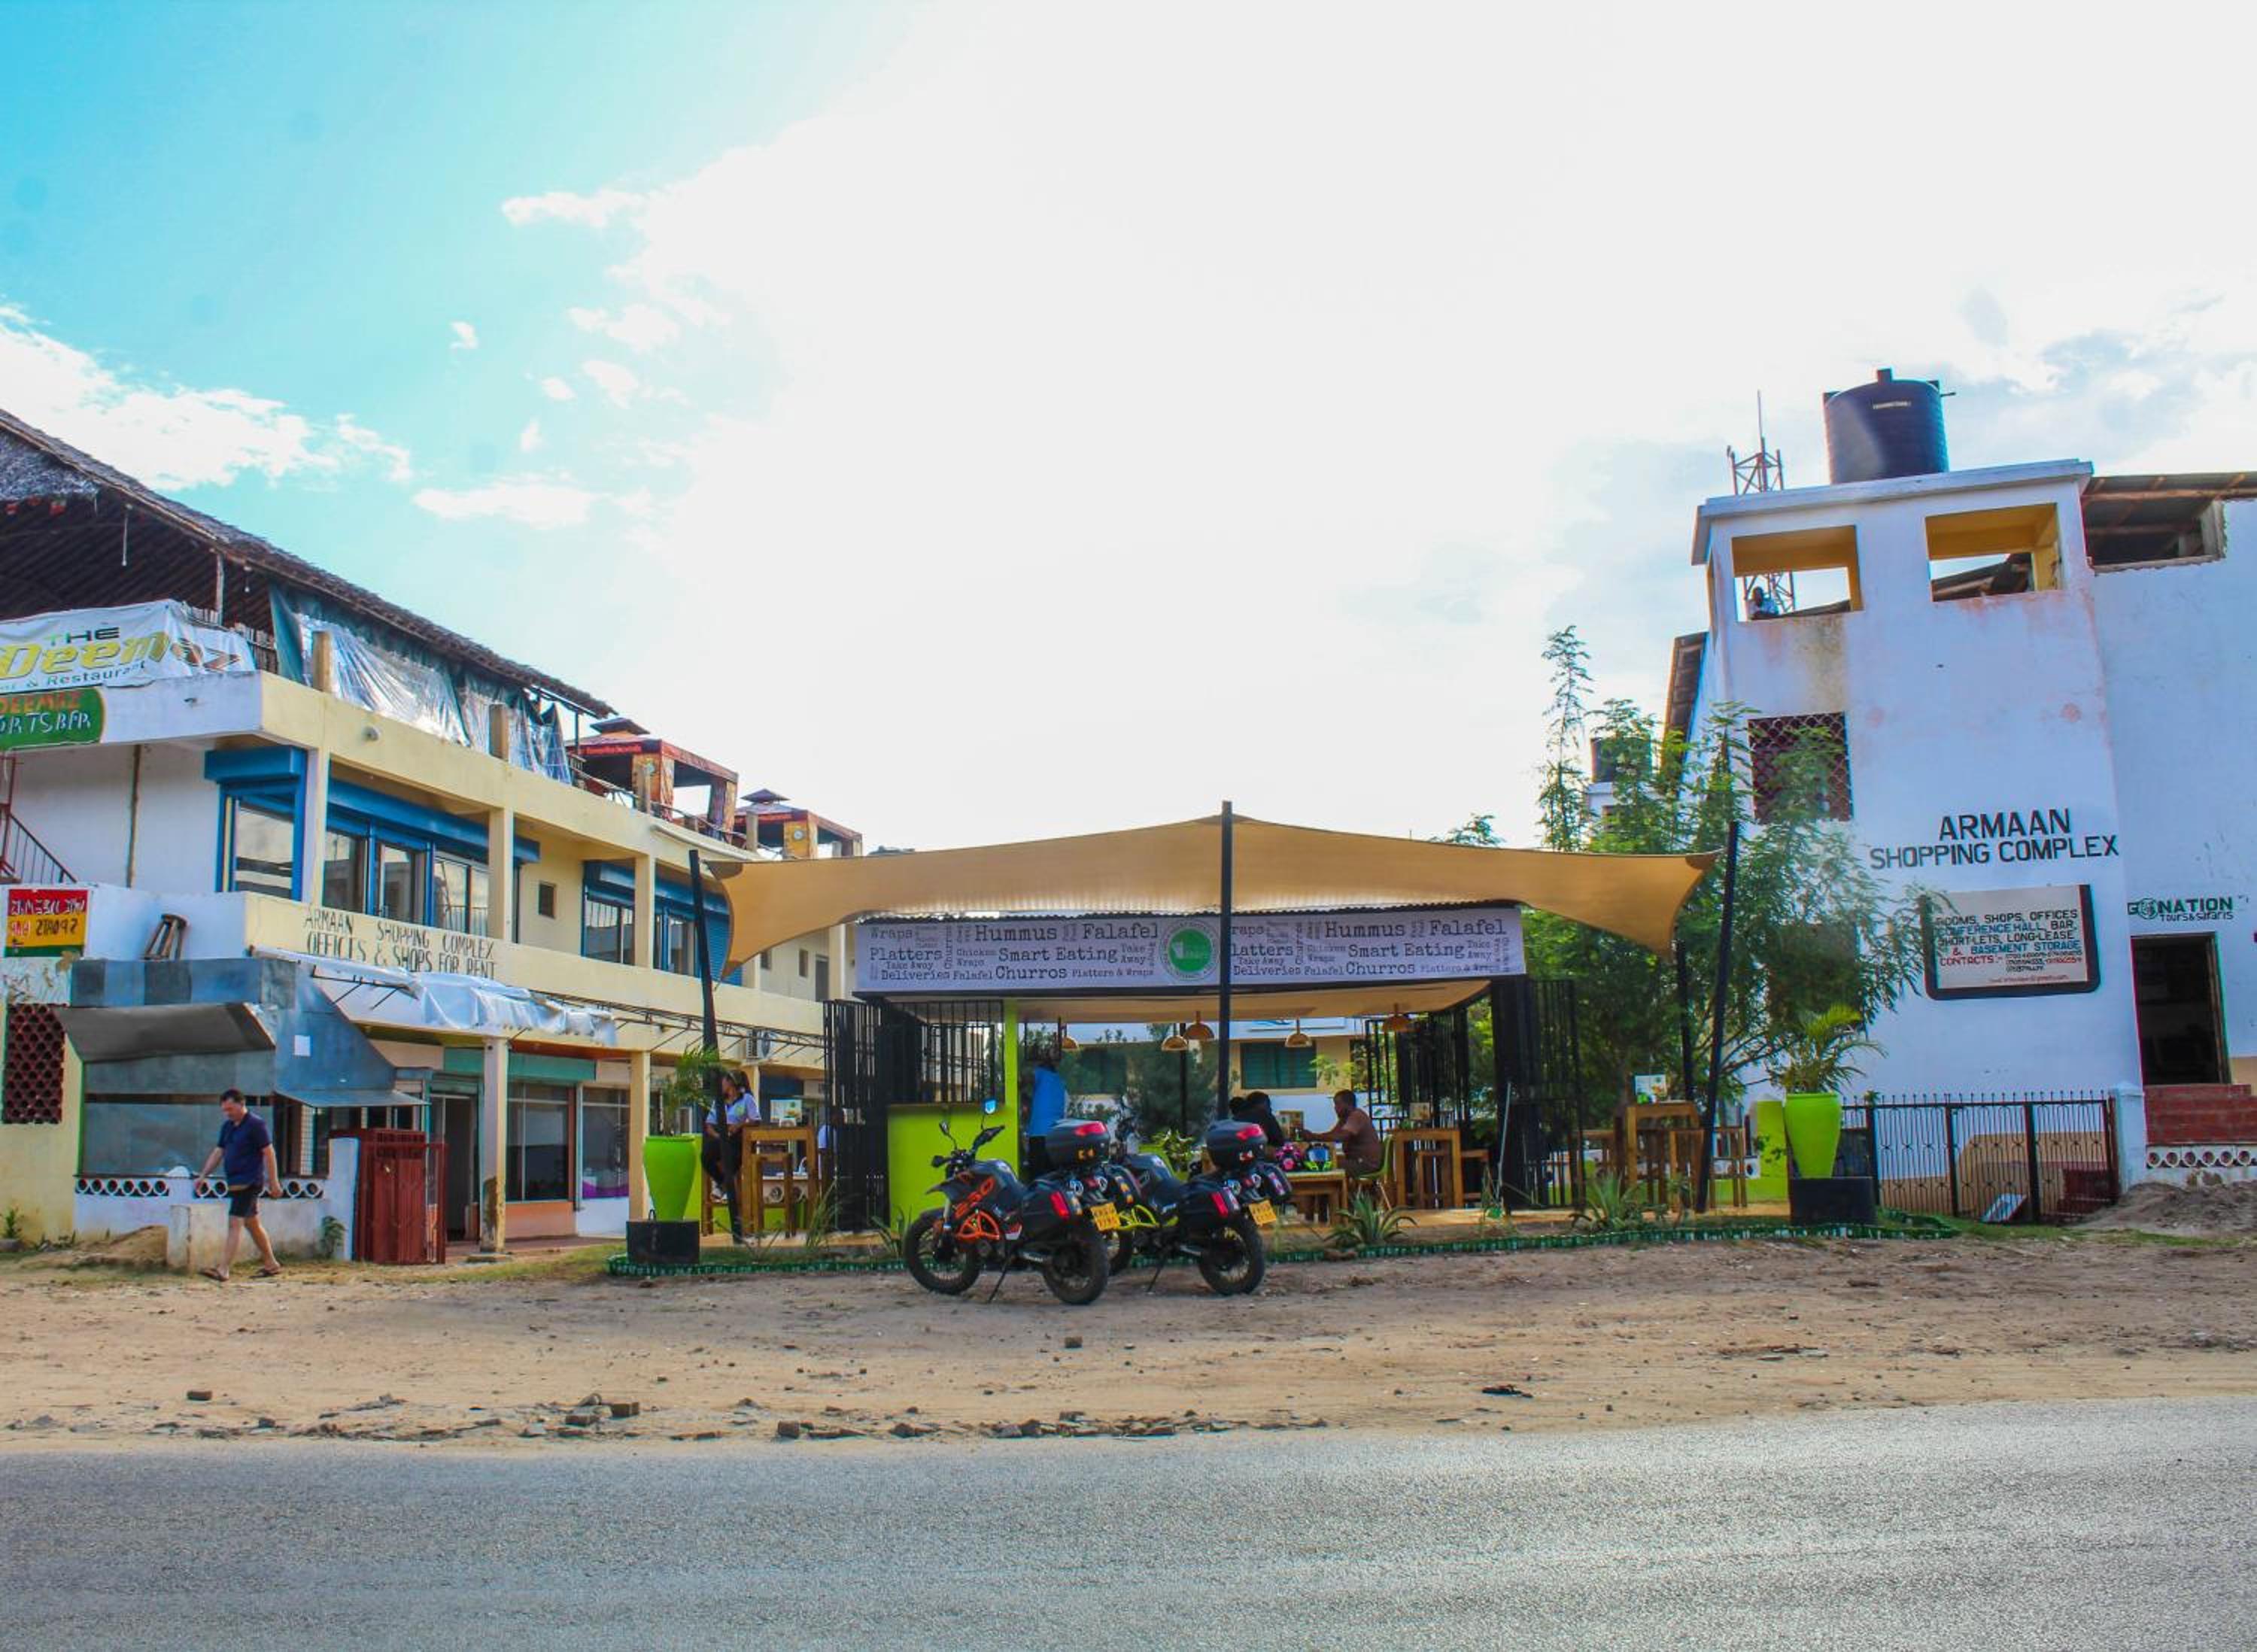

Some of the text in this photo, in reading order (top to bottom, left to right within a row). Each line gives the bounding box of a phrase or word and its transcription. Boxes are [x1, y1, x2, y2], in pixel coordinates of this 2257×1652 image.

[1938, 808, 2071, 841] ARMAAN
[1869, 834, 2119, 869] SHOPPING COMPLEX
[2030, 910, 2078, 922] OFFICES
[305, 906, 494, 960] ARMAAN SHOPPING COMPLEX
[974, 925, 1058, 942] Hummus
[1082, 922, 1159, 940] Falafel
[1232, 926, 1265, 939] raps
[1325, 921, 1405, 939] Hummus
[1428, 918, 1507, 936] Falafel
[870, 946, 943, 961] Platters
[998, 946, 1118, 964] Smart Eating
[1231, 943, 1294, 956] latters
[1348, 941, 1465, 959] Smart Eating
[1971, 943, 2028, 955] BASEMENT
[393, 943, 433, 973] SHOPS
[881, 969, 951, 981] Deliveries
[995, 965, 1068, 980] Churros
[1233, 965, 1302, 976] Deliveries
[1346, 961, 1415, 976] Churros
